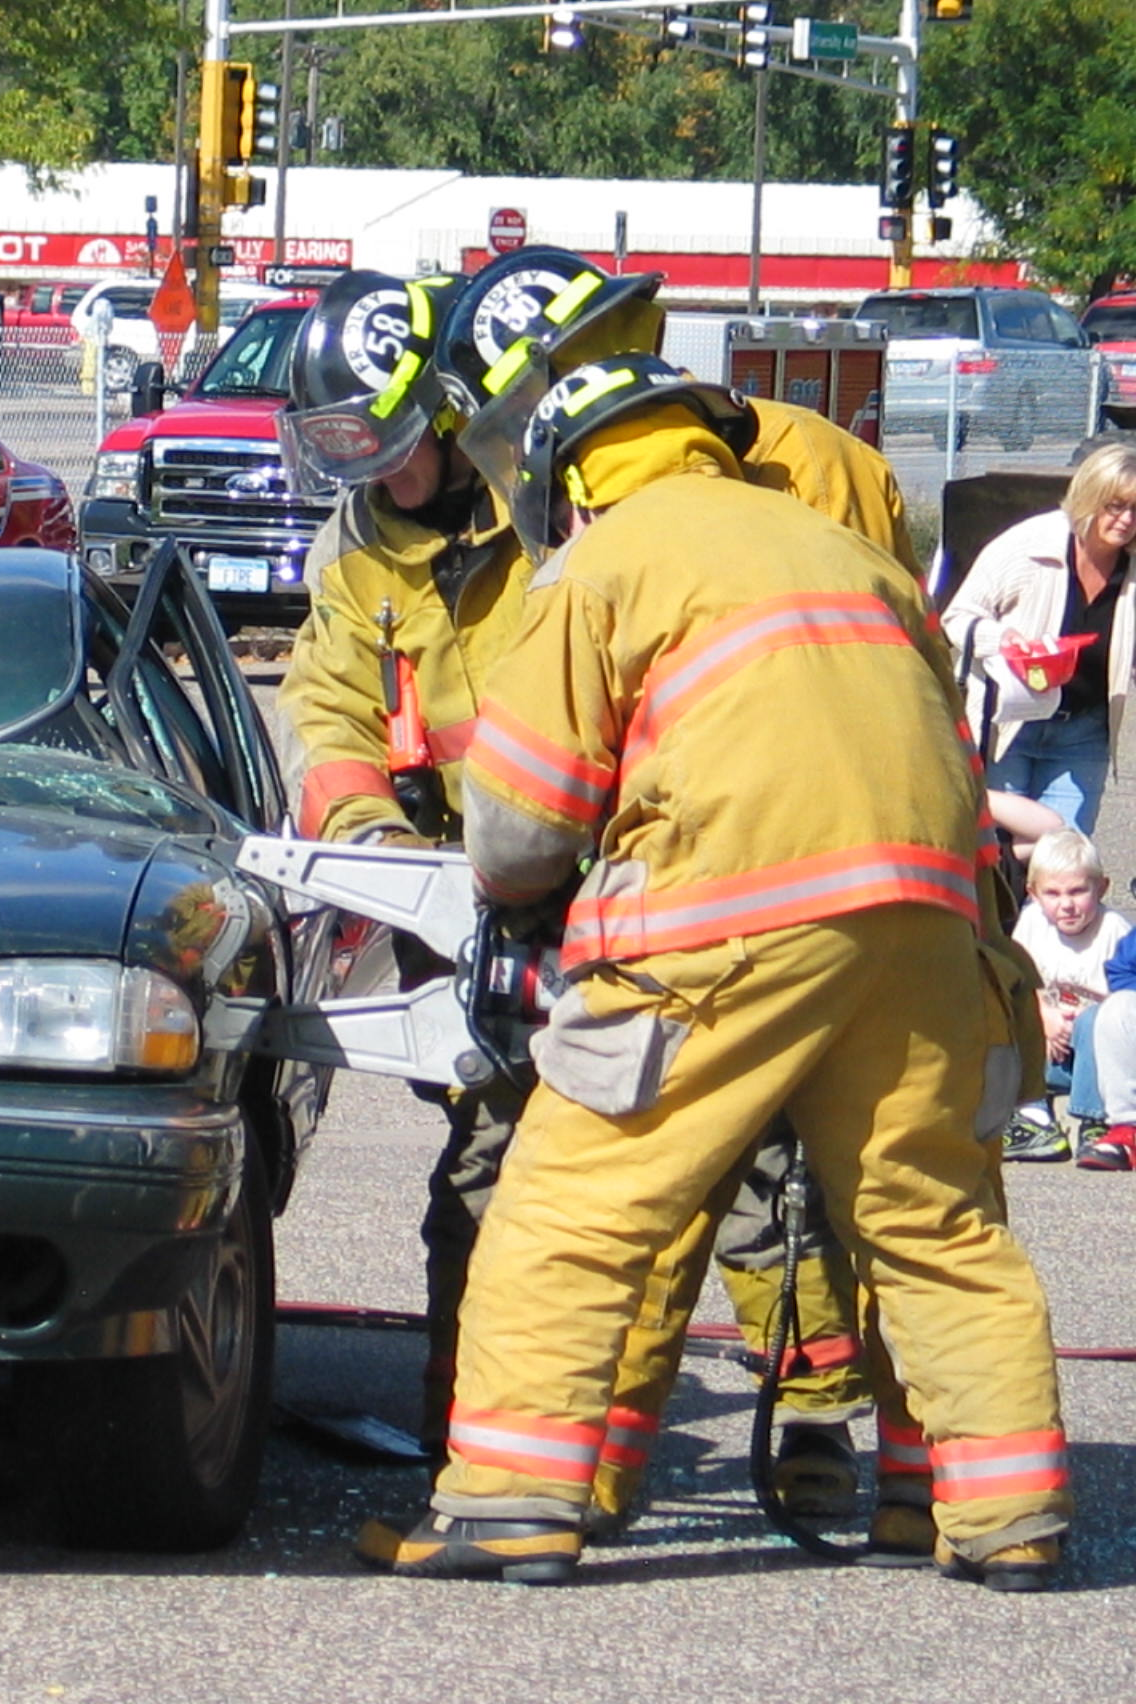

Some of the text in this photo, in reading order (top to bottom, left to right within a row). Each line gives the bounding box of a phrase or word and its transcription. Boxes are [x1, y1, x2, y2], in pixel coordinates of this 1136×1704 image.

[279, 240, 348, 263] EARING
[348, 291, 382, 374] FRDLEY
[491, 286, 542, 333] 56
[365, 312, 411, 361] 58
[223, 568, 253, 584] FIRE
